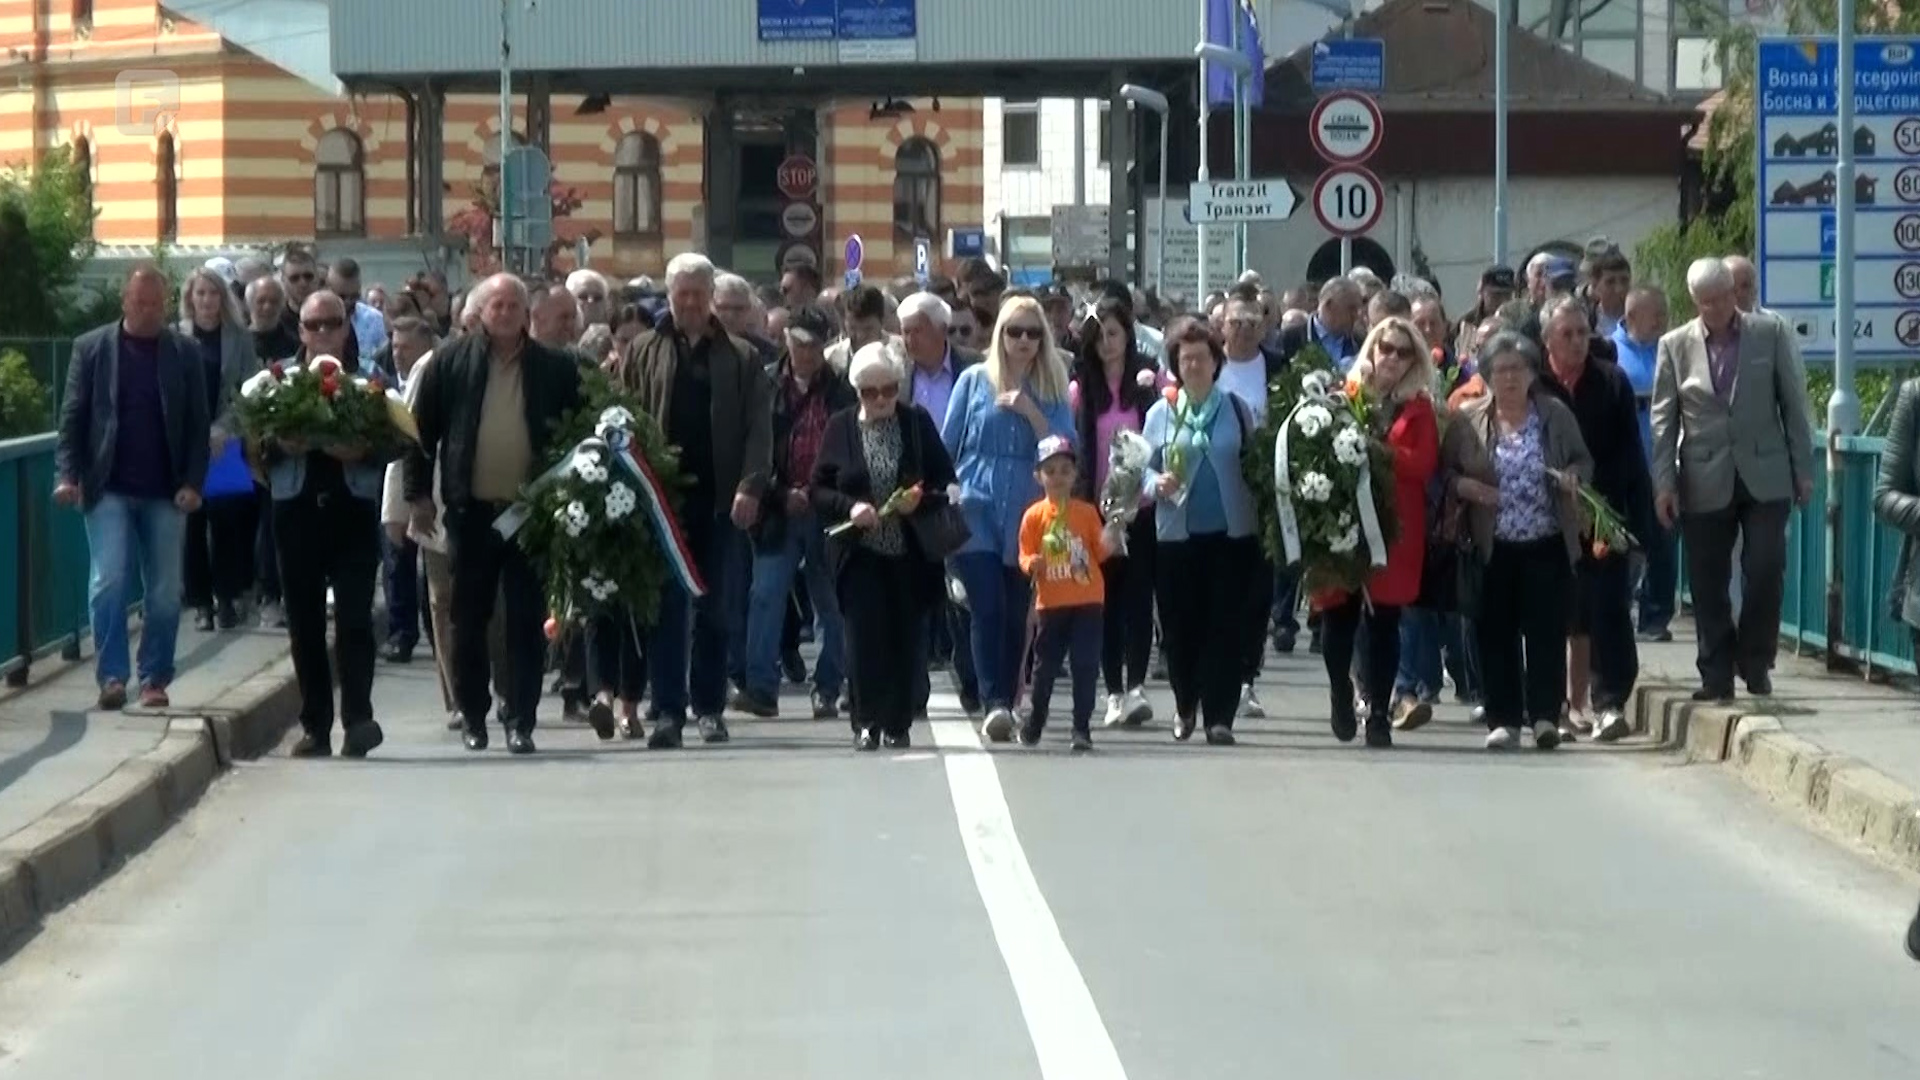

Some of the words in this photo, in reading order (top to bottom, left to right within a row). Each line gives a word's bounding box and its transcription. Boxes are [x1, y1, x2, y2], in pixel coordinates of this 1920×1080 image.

[1769, 68, 1818, 87] Bosna
[1824, 68, 1829, 87] i
[1834, 67, 1920, 91] rcegovin
[1763, 91, 1812, 111] Босна
[1817, 96, 1827, 110] и
[1833, 92, 1920, 113] рцегови
[1901, 127, 1920, 147] 50
[781, 168, 816, 186] STOP
[1901, 175, 1920, 195] 80
[1211, 184, 1267, 198] Tranzit
[1335, 183, 1367, 219] 10
[1205, 204, 1272, 220] Транзит
[916, 243, 926, 270] P
